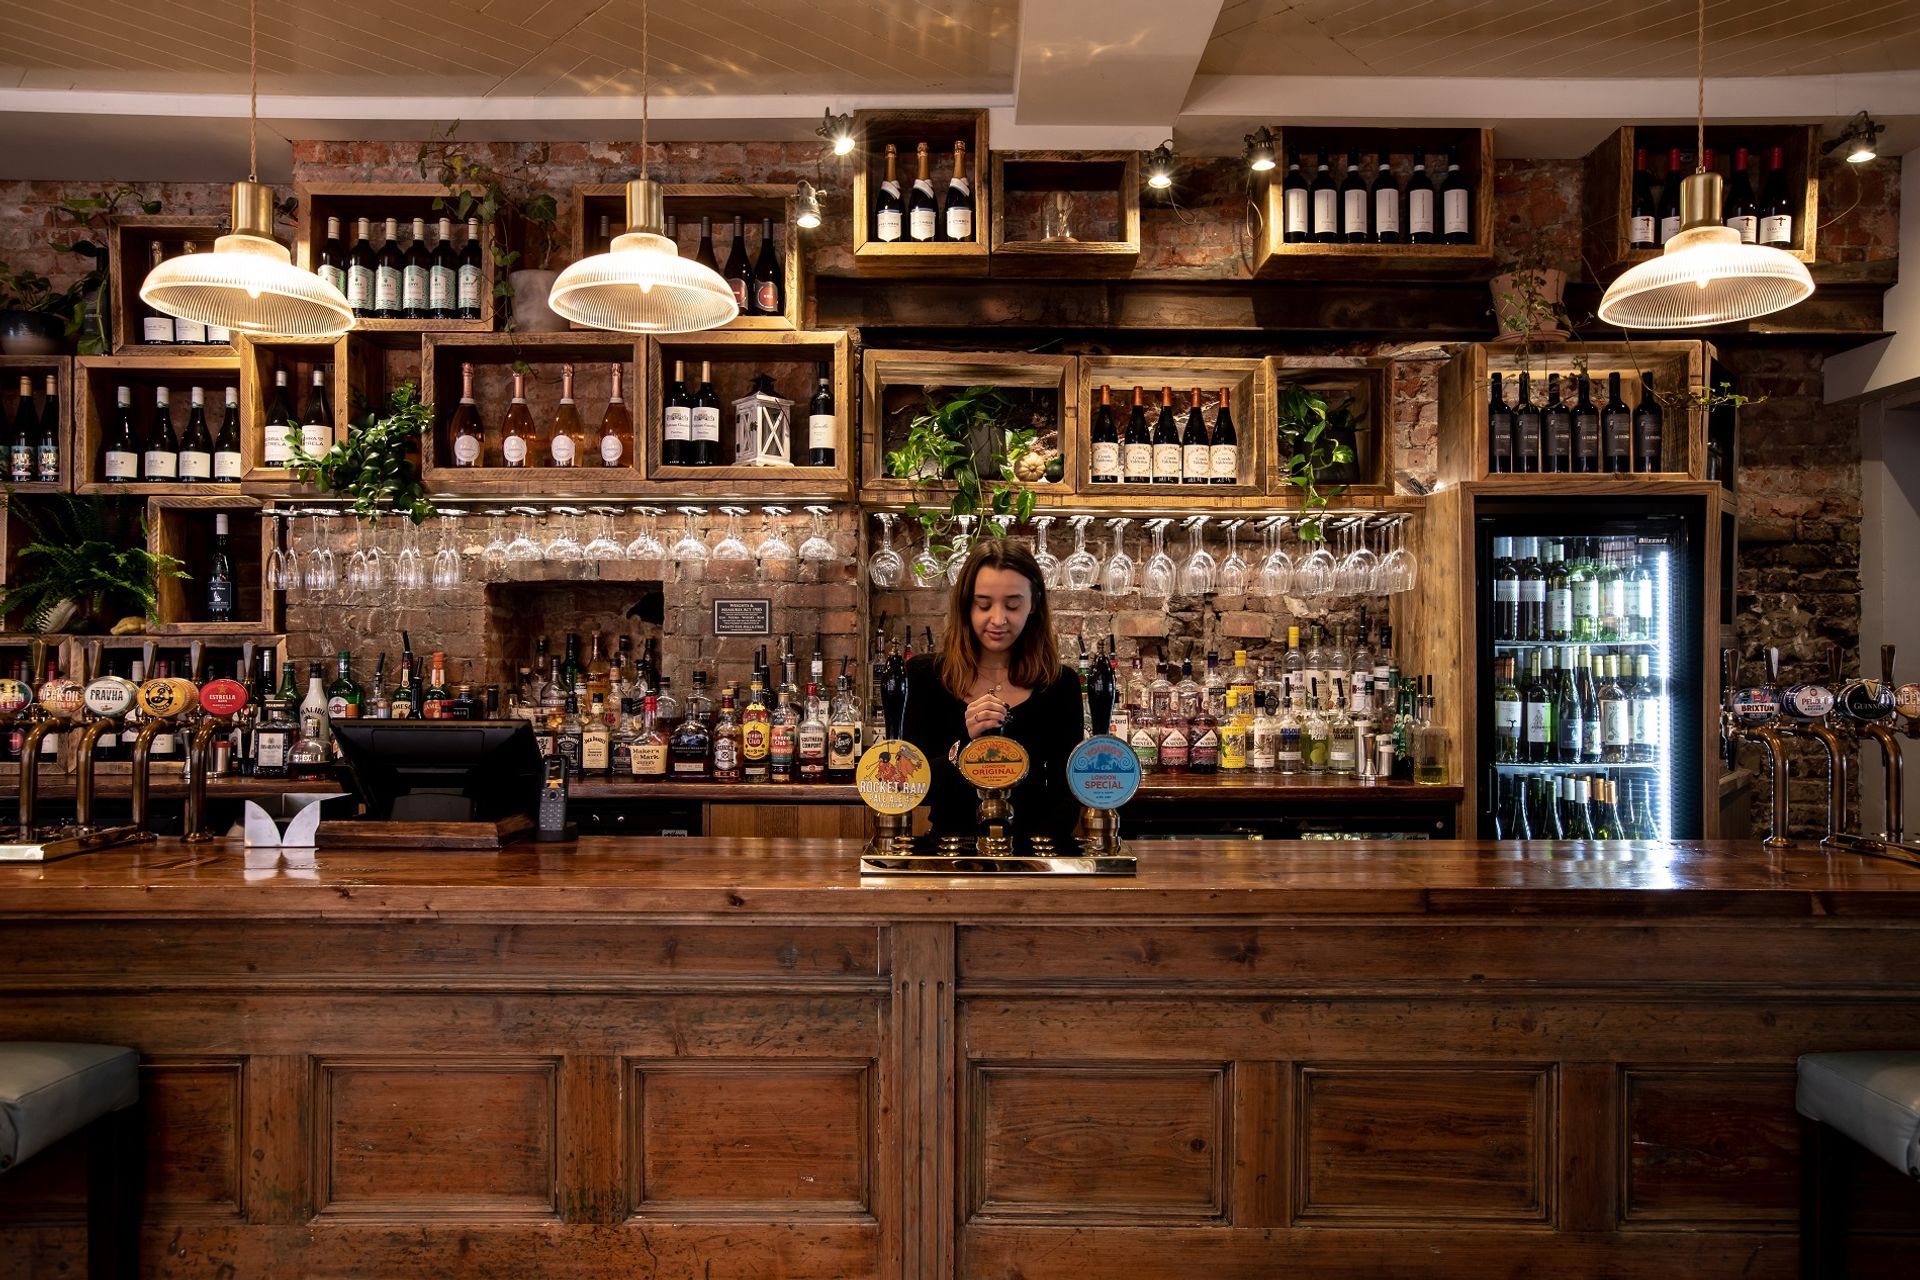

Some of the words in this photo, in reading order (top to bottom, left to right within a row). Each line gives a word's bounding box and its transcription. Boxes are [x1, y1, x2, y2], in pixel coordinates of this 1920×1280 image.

[65, 690, 81, 702] OIL
[90, 689, 124, 701] PRAVHA
[1741, 704, 1775, 712] BRIXTON
[1853, 702, 1889, 710] GUINNESS
[975, 742, 1011, 752] YOUNG'S
[1084, 744, 1124, 757] YOUNG'S
[972, 768, 1017, 776] ORIGINAL
[860, 780, 900, 794] ROCKET
[903, 782, 926, 794] RAM
[1084, 781, 1124, 789] SPECIAL
